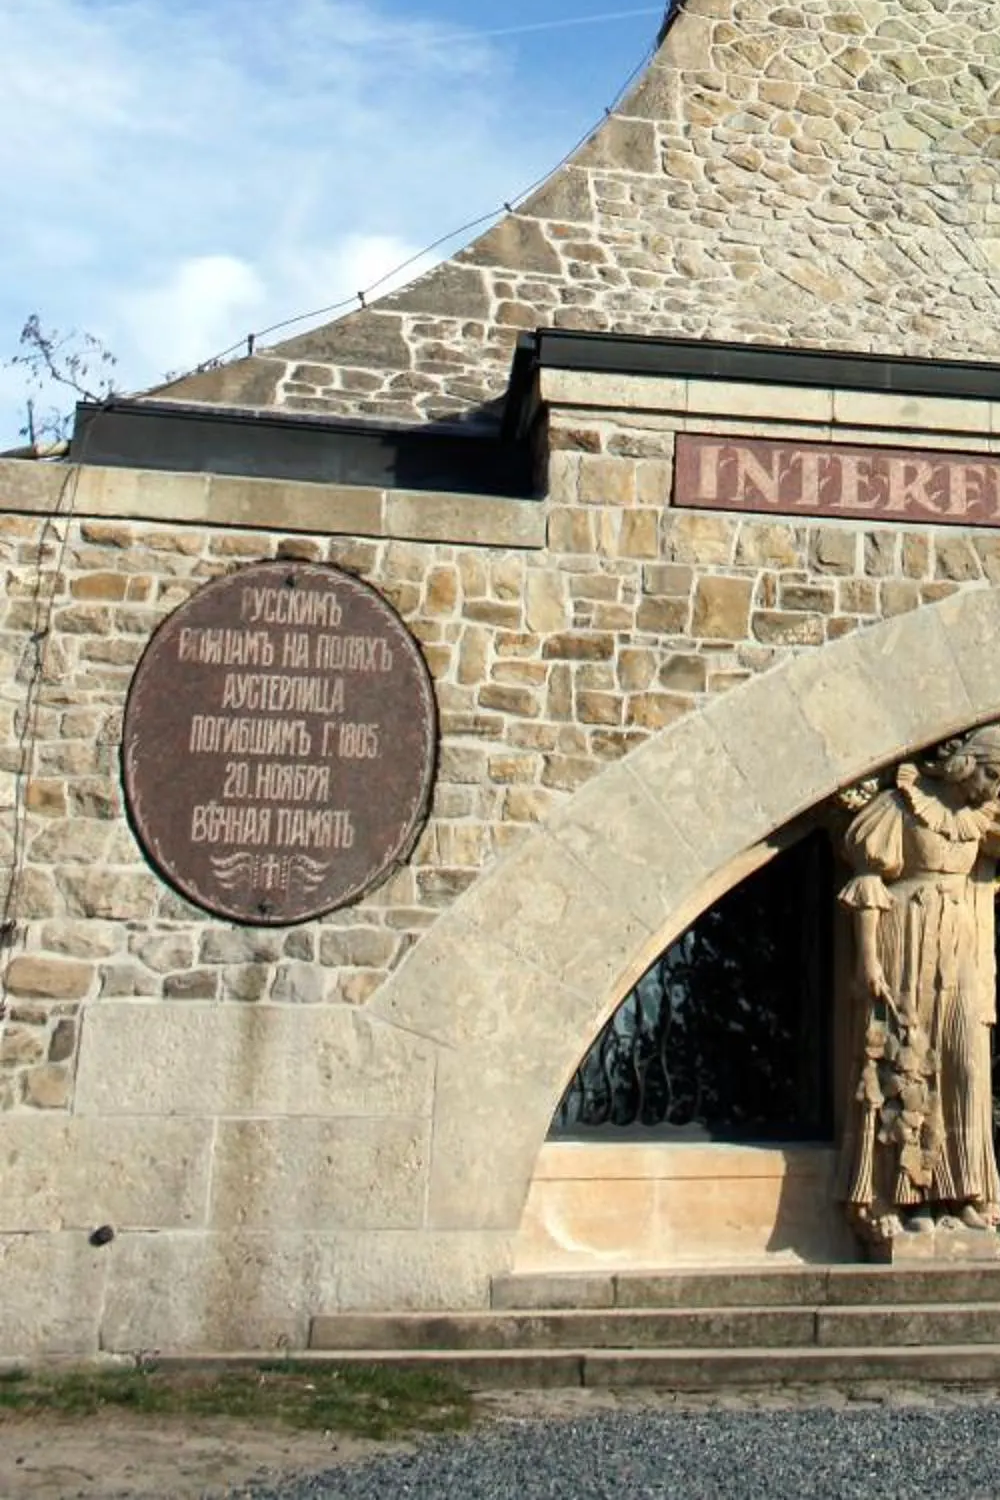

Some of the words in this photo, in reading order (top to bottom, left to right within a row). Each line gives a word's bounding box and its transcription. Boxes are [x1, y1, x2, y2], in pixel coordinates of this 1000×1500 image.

[240, 587, 343, 628] РУССКИМЪ
[281, 632, 310, 668] НА
[189, 715, 312, 757] ПОГИБШИМЪ
[277, 807, 355, 848] ПАМЯТЬ
